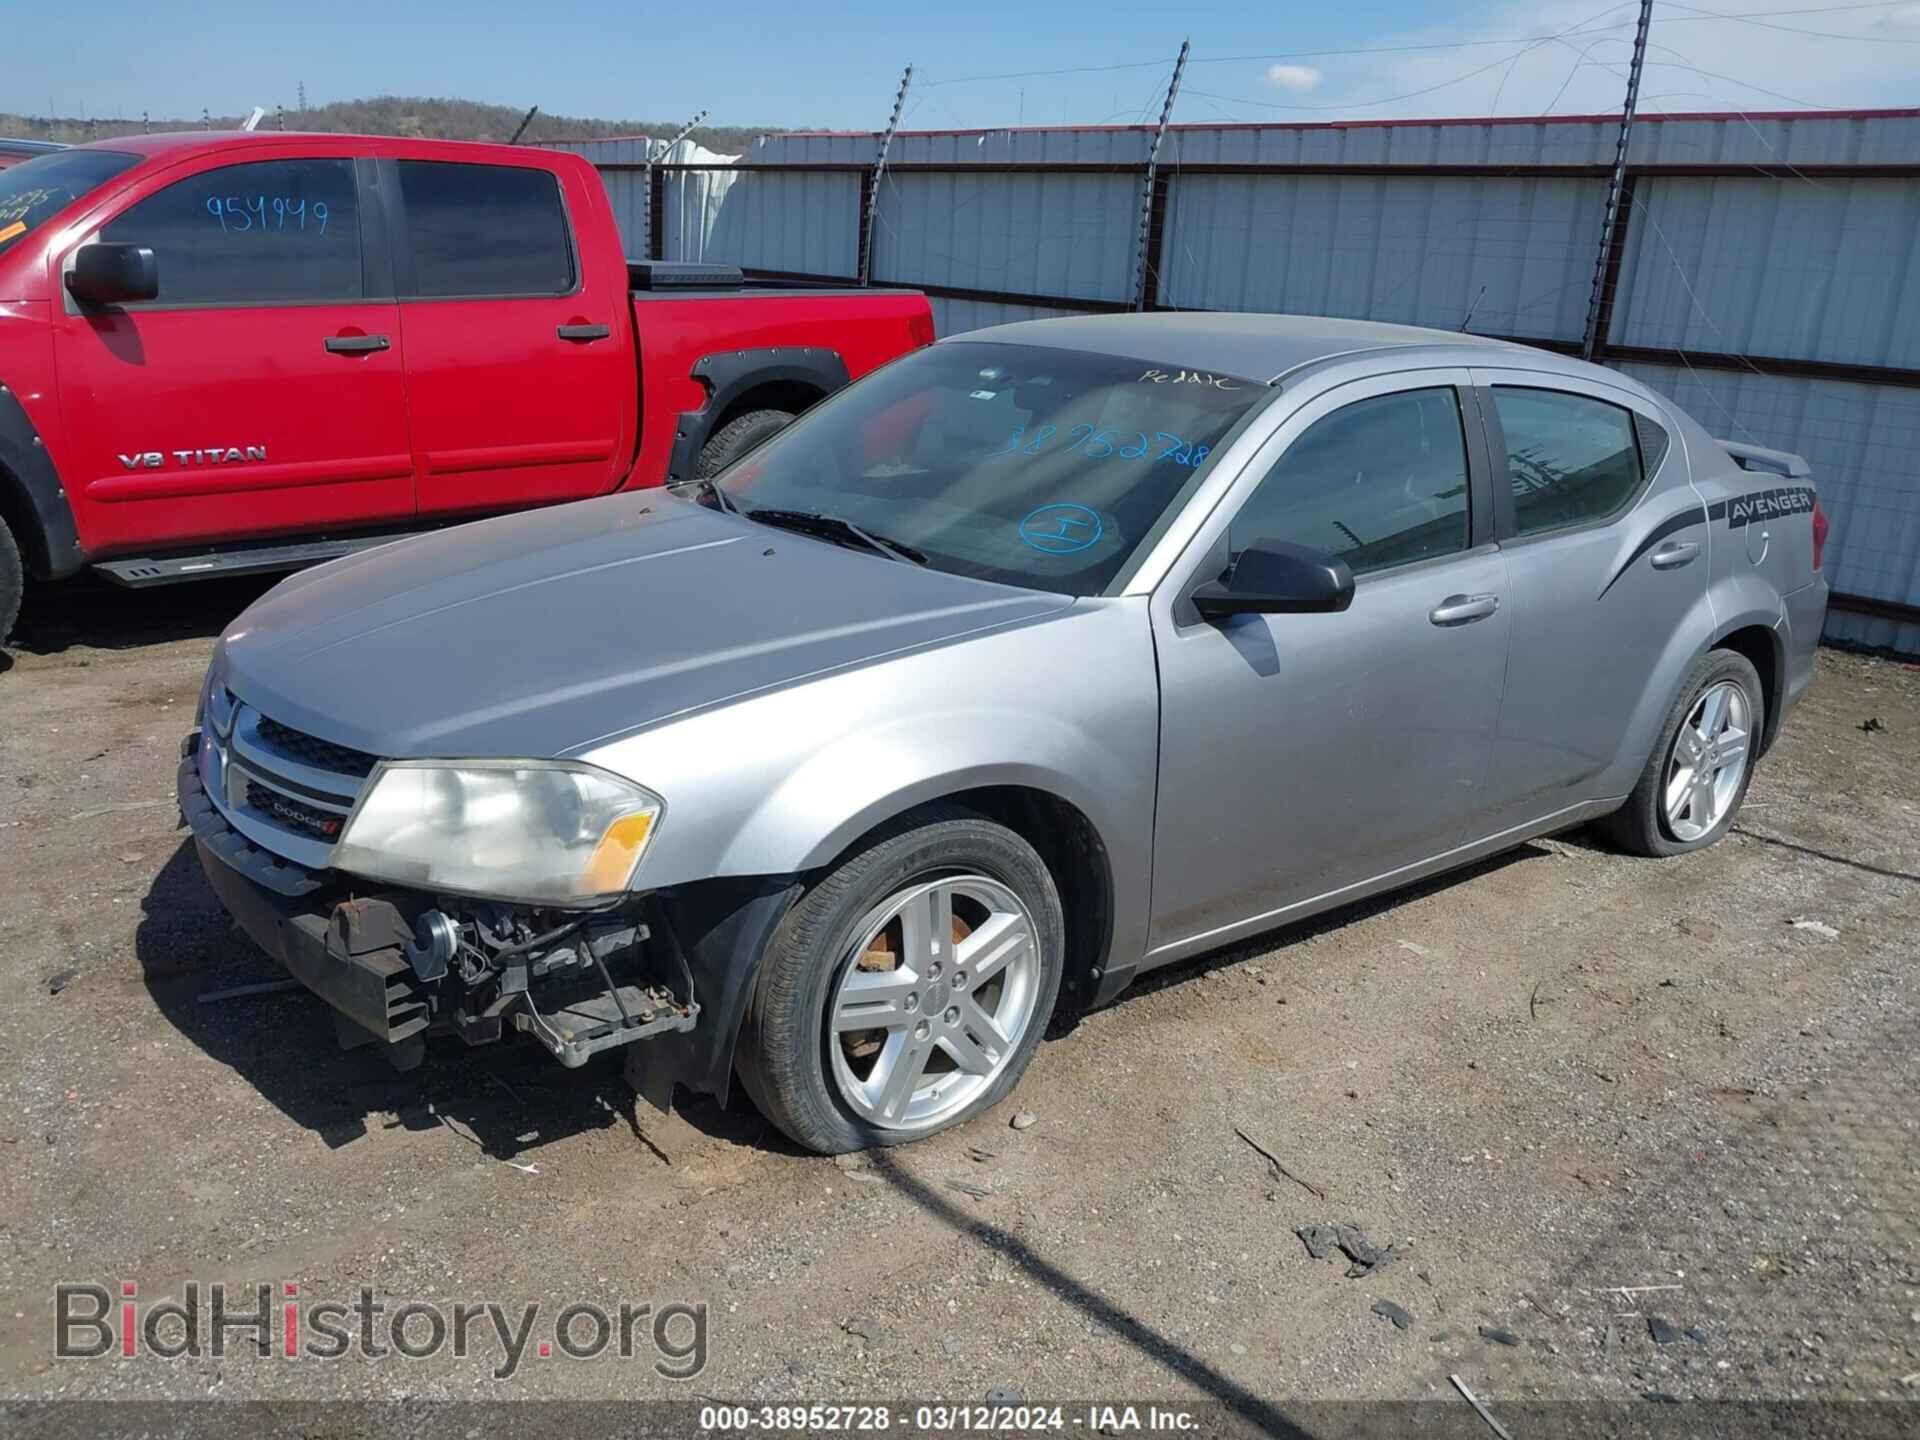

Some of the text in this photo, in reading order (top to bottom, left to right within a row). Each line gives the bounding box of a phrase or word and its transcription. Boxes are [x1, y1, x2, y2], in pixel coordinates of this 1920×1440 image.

[206, 196, 329, 235] 954949
[118, 445, 267, 469] V8 TITAN
[1732, 493, 1811, 519] AVENGER
[273, 802, 325, 829] DODGE
